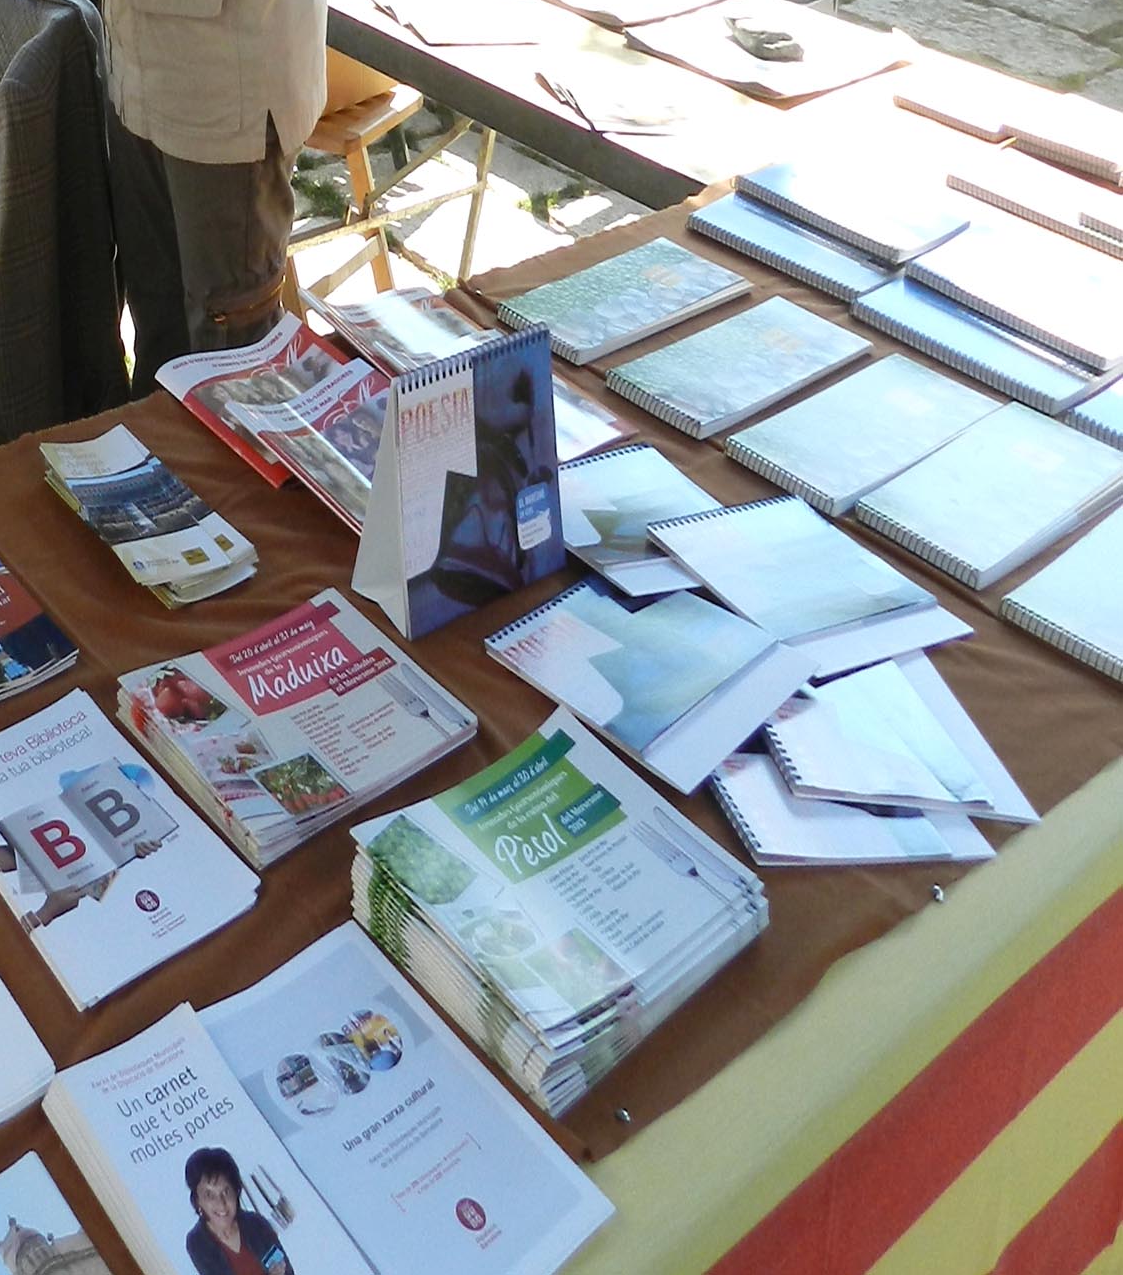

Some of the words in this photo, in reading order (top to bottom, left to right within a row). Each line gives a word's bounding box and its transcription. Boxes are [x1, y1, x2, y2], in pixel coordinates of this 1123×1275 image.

[229, 653, 241, 664] Del
[290, 628, 299, 638] de
[298, 619, 316, 633] maig
[247, 646, 349, 706] Maduixa
[329, 675, 340, 686] de
[340, 671, 349, 682] la
[8, 758, 34, 781] tua
[32, 726, 94, 767] biblioteca!
[25, 708, 88, 751] Biblioteca
[488, 791, 498, 804] de
[514, 776, 522, 789] al
[529, 755, 550, 777] d'abril
[84, 787, 142, 840] B
[560, 810, 573, 826] del
[30, 818, 87, 870] B
[494, 812, 568, 875] Pèsol
[116, 1096, 145, 1118] Un
[144, 1065, 199, 1107] carnet
[129, 1115, 161, 1140] que
[160, 1084, 210, 1124] t'obre
[342, 1136, 363, 1154] Una
[362, 1120, 383, 1141] gran
[381, 1103, 406, 1125] xarxa
[404, 1076, 436, 1107] cultural
[129, 1127, 184, 1166] moltes
[186, 1096, 236, 1140] portes
